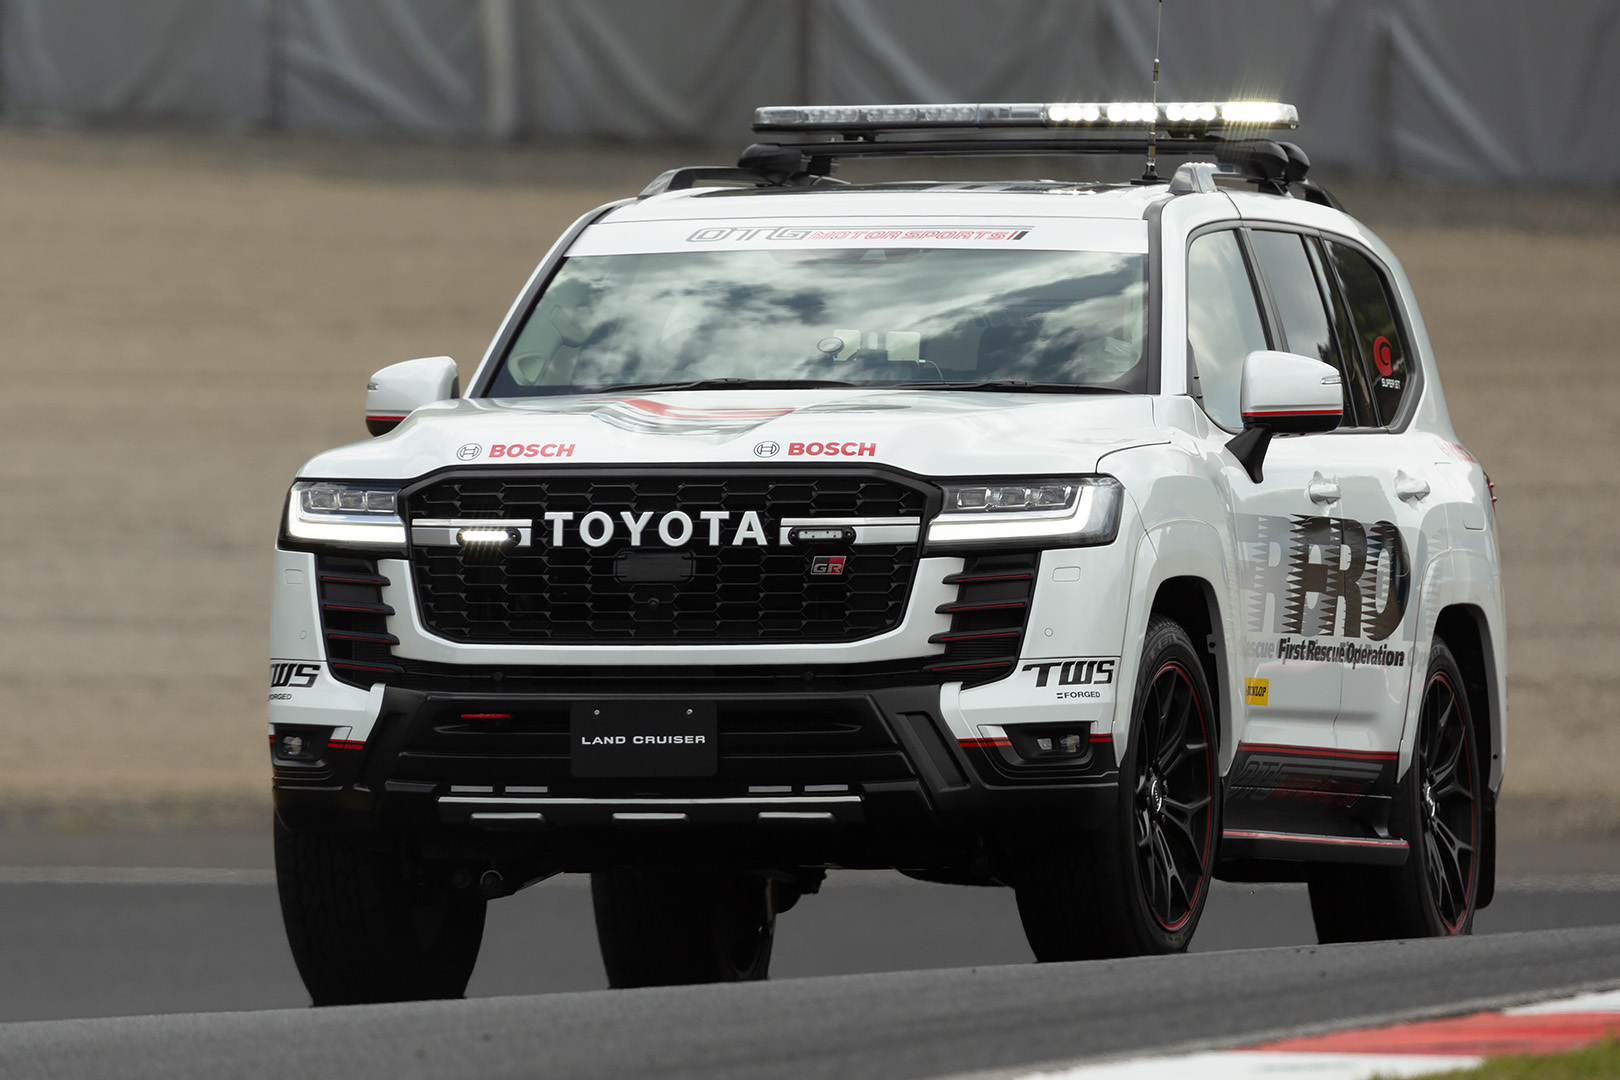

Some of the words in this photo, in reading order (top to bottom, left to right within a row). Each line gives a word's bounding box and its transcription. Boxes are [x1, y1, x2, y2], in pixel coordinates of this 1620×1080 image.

[686, 226, 813, 242] OTG
[488, 443, 576, 458] BOSCH
[788, 442, 877, 457] BOSCH
[544, 510, 769, 547] TOYOTA
[812, 562, 843, 573] GR
[1277, 638, 1307, 660] First
[1306, 640, 1345, 663] Rescue
[1345, 641, 1405, 669] Operation
[271, 663, 321, 688] WS
[1022, 660, 1115, 688] TWS
[1064, 691, 1101, 699] FORGED
[581, 736, 627, 745] LAND
[632, 735, 706, 745] CRUISER
